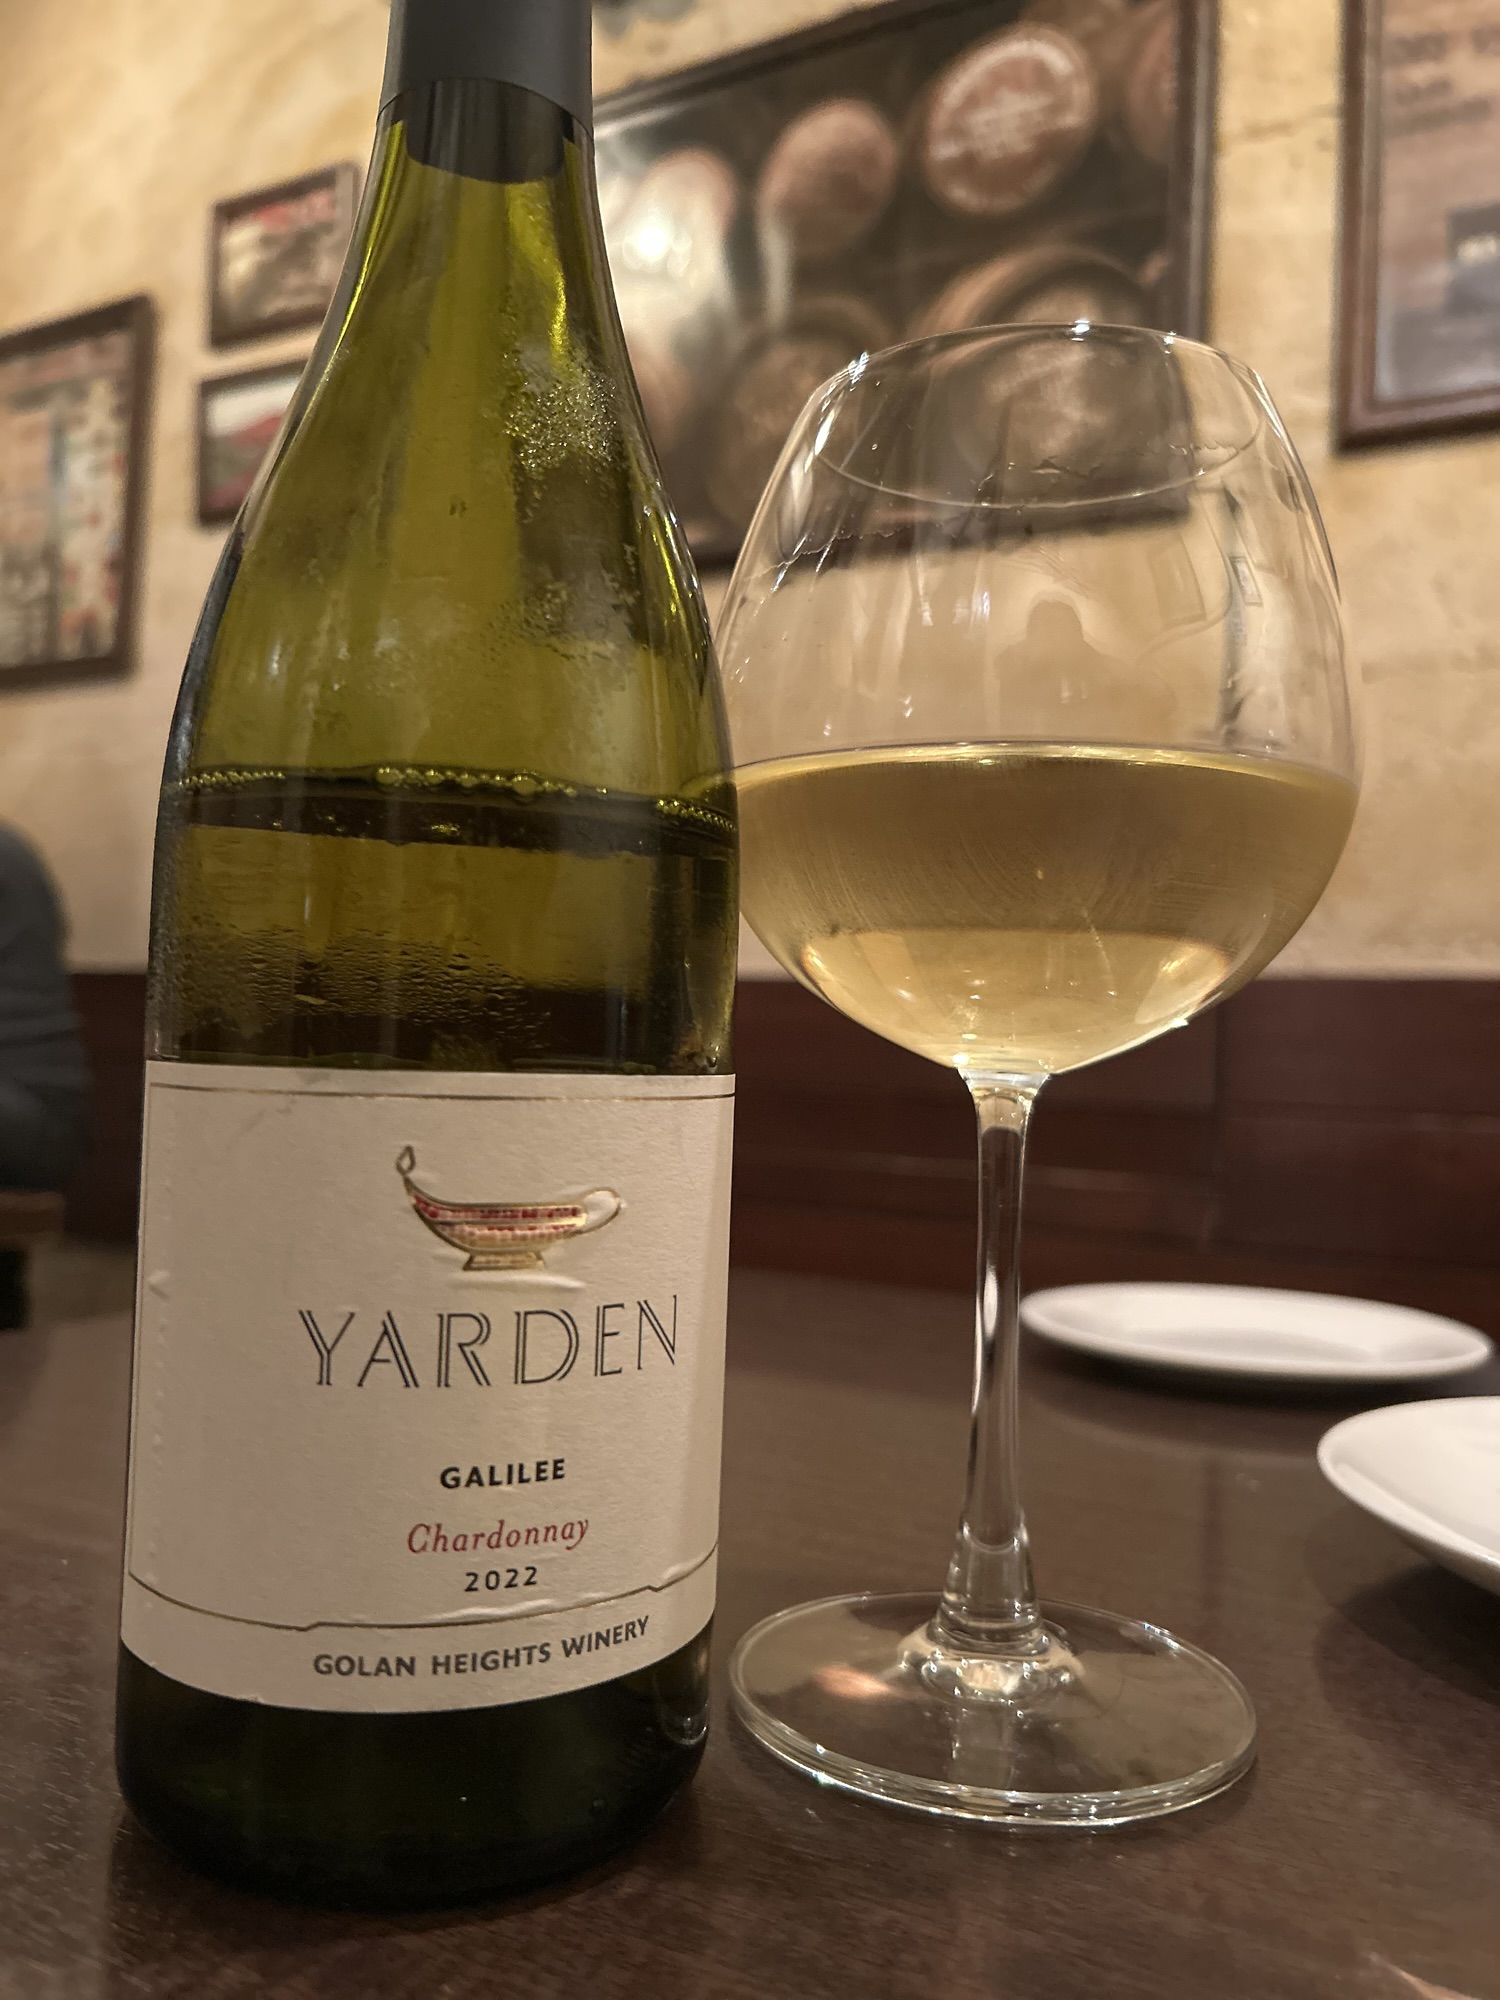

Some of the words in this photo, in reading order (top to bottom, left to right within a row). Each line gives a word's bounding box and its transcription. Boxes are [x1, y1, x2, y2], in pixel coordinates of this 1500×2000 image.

[298, 1295, 678, 1388] YARDEN
[440, 1458, 566, 1489] GALILEE
[408, 1519, 590, 1554] Chardonnay
[464, 1566, 539, 1592] 2022
[313, 1653, 417, 1677] GOLAN
[431, 1643, 552, 1676] HEIGHTS
[561, 1615, 650, 1658] WINERY
